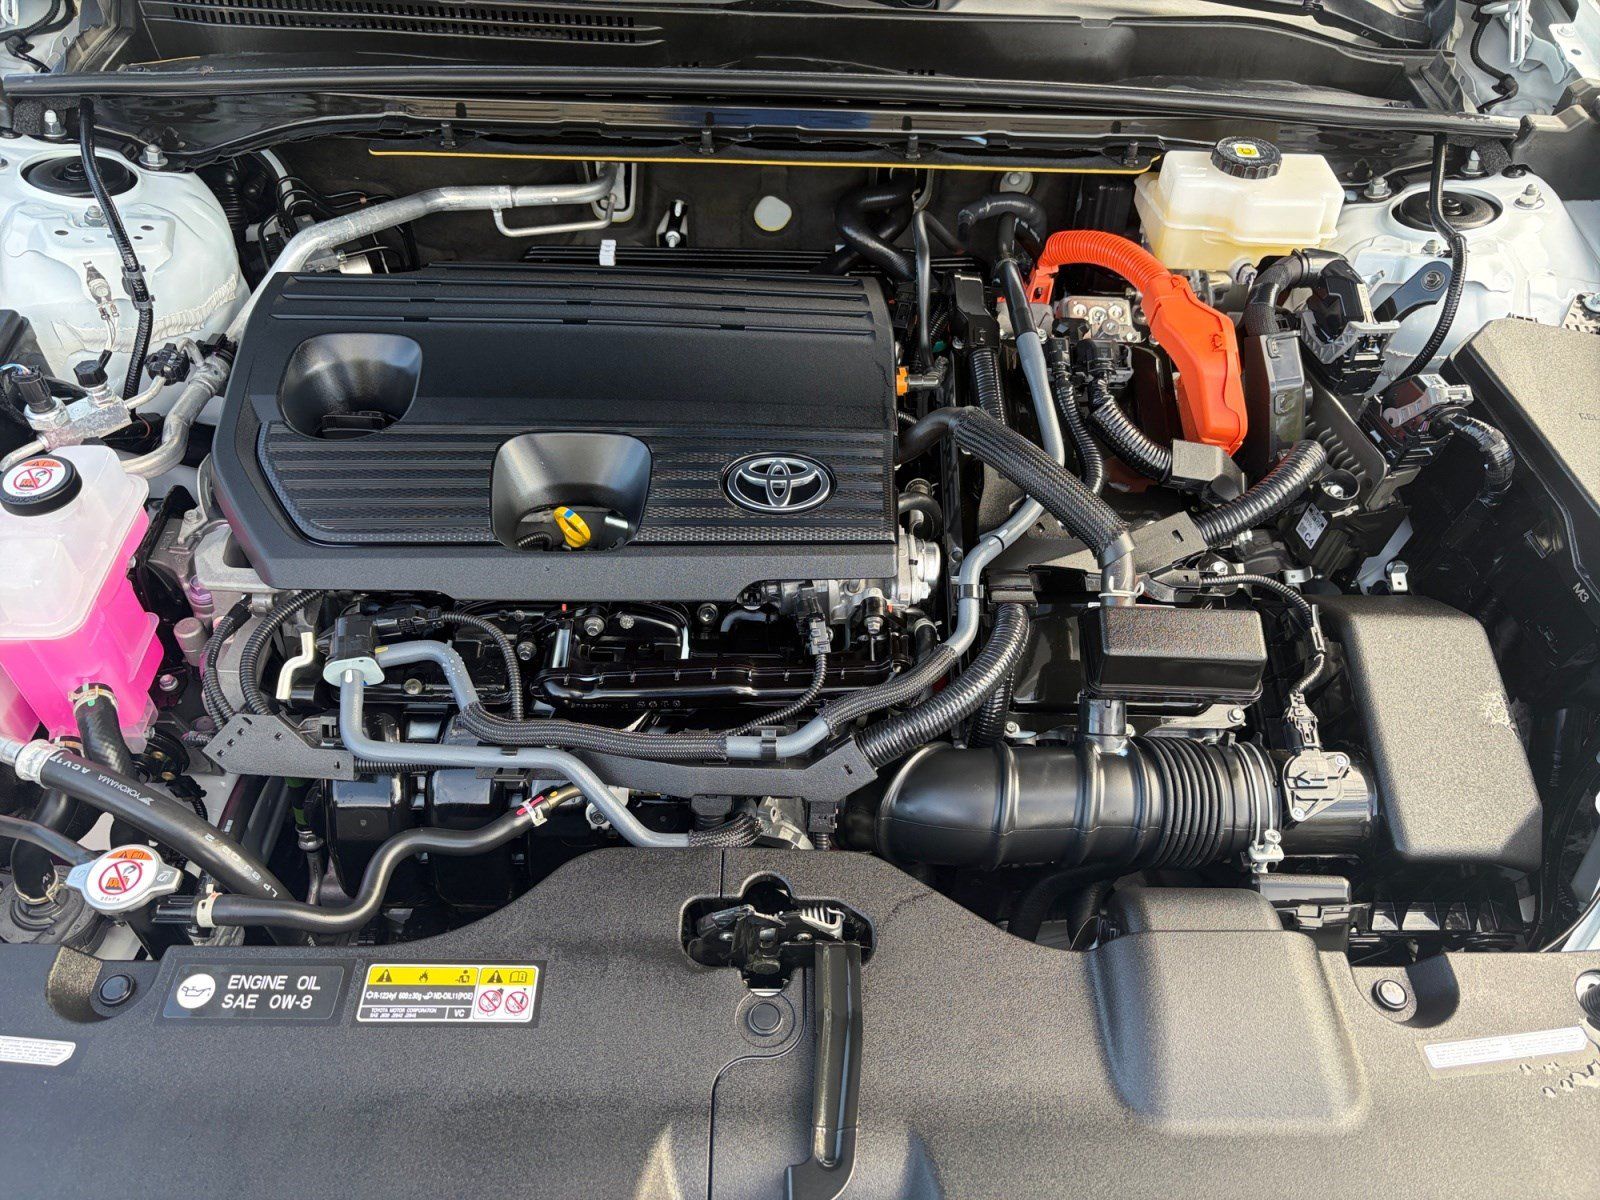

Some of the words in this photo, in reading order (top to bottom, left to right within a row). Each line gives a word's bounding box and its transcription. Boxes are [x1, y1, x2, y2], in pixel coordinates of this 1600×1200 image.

[1572, 582, 1590, 603] M3
[98, 773, 141, 800] YOKOHAMA
[263, 883, 278, 898] LP
[227, 974, 288, 991] ENGINE
[296, 975, 321, 991] OIL
[221, 993, 259, 1009] SAE
[454, 1009, 466, 1018] VC
